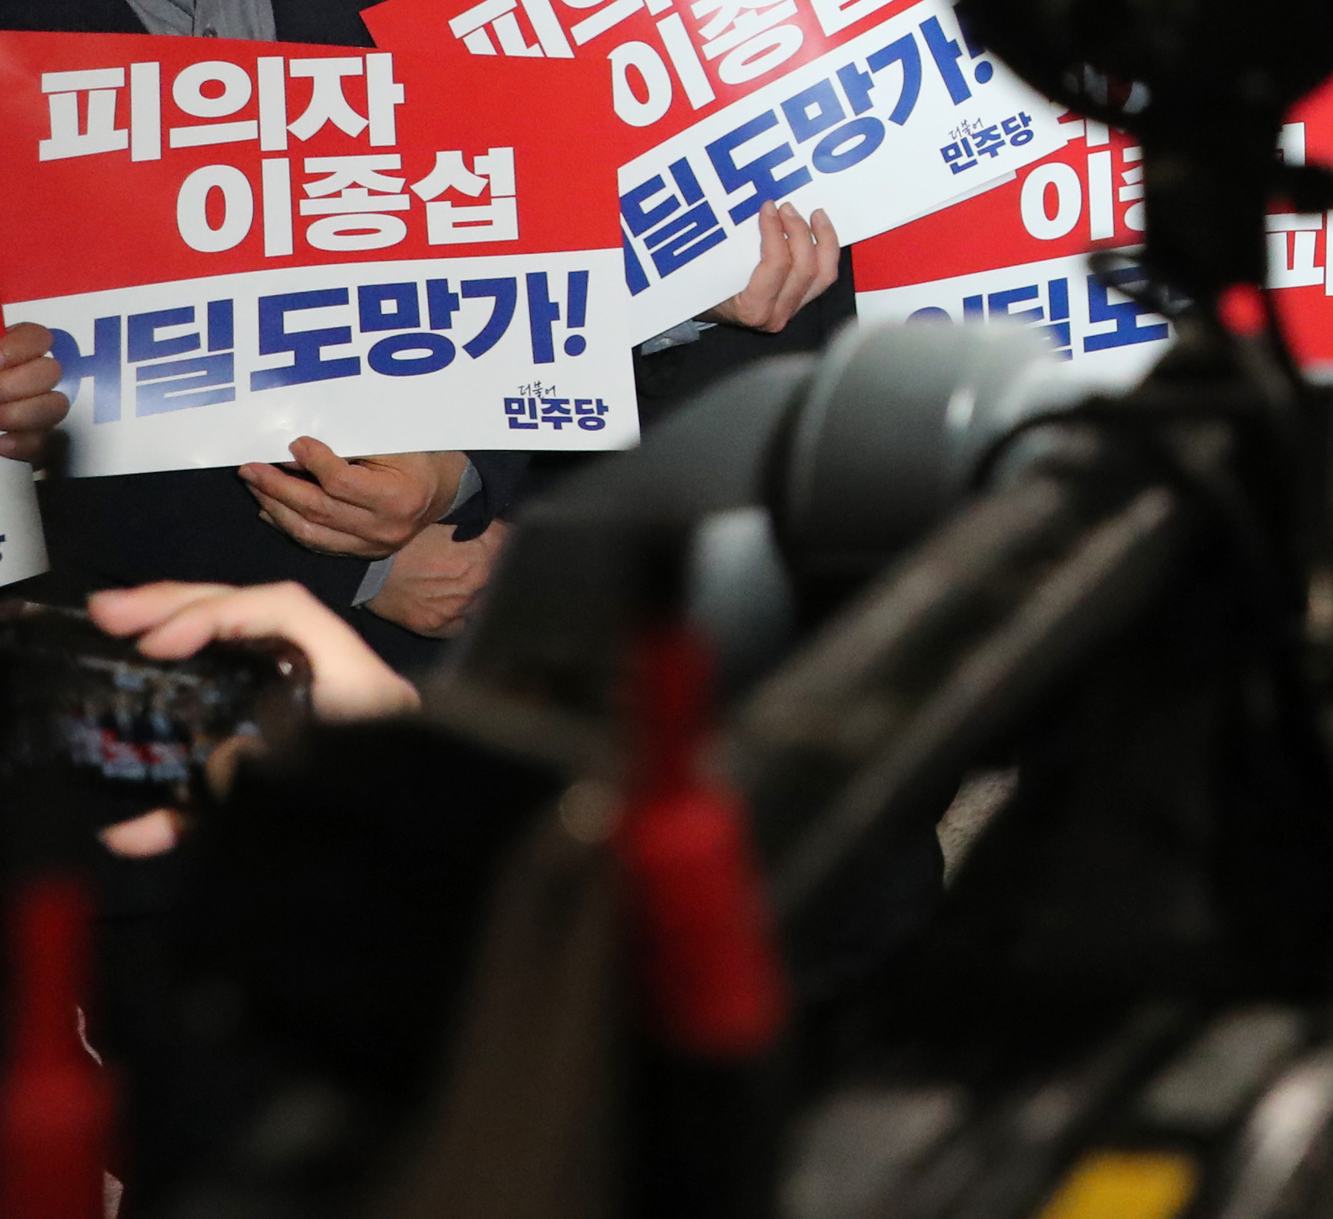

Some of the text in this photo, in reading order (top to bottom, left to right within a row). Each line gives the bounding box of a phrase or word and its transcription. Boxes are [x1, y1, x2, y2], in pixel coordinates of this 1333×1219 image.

[38, 53, 405, 162] 피의자
[940, 111, 1034, 175] 민주당
[176, 146, 519, 258] 이종섭
[250, 270, 590, 392] 도망가!
[504, 396, 609, 432] 민주당
